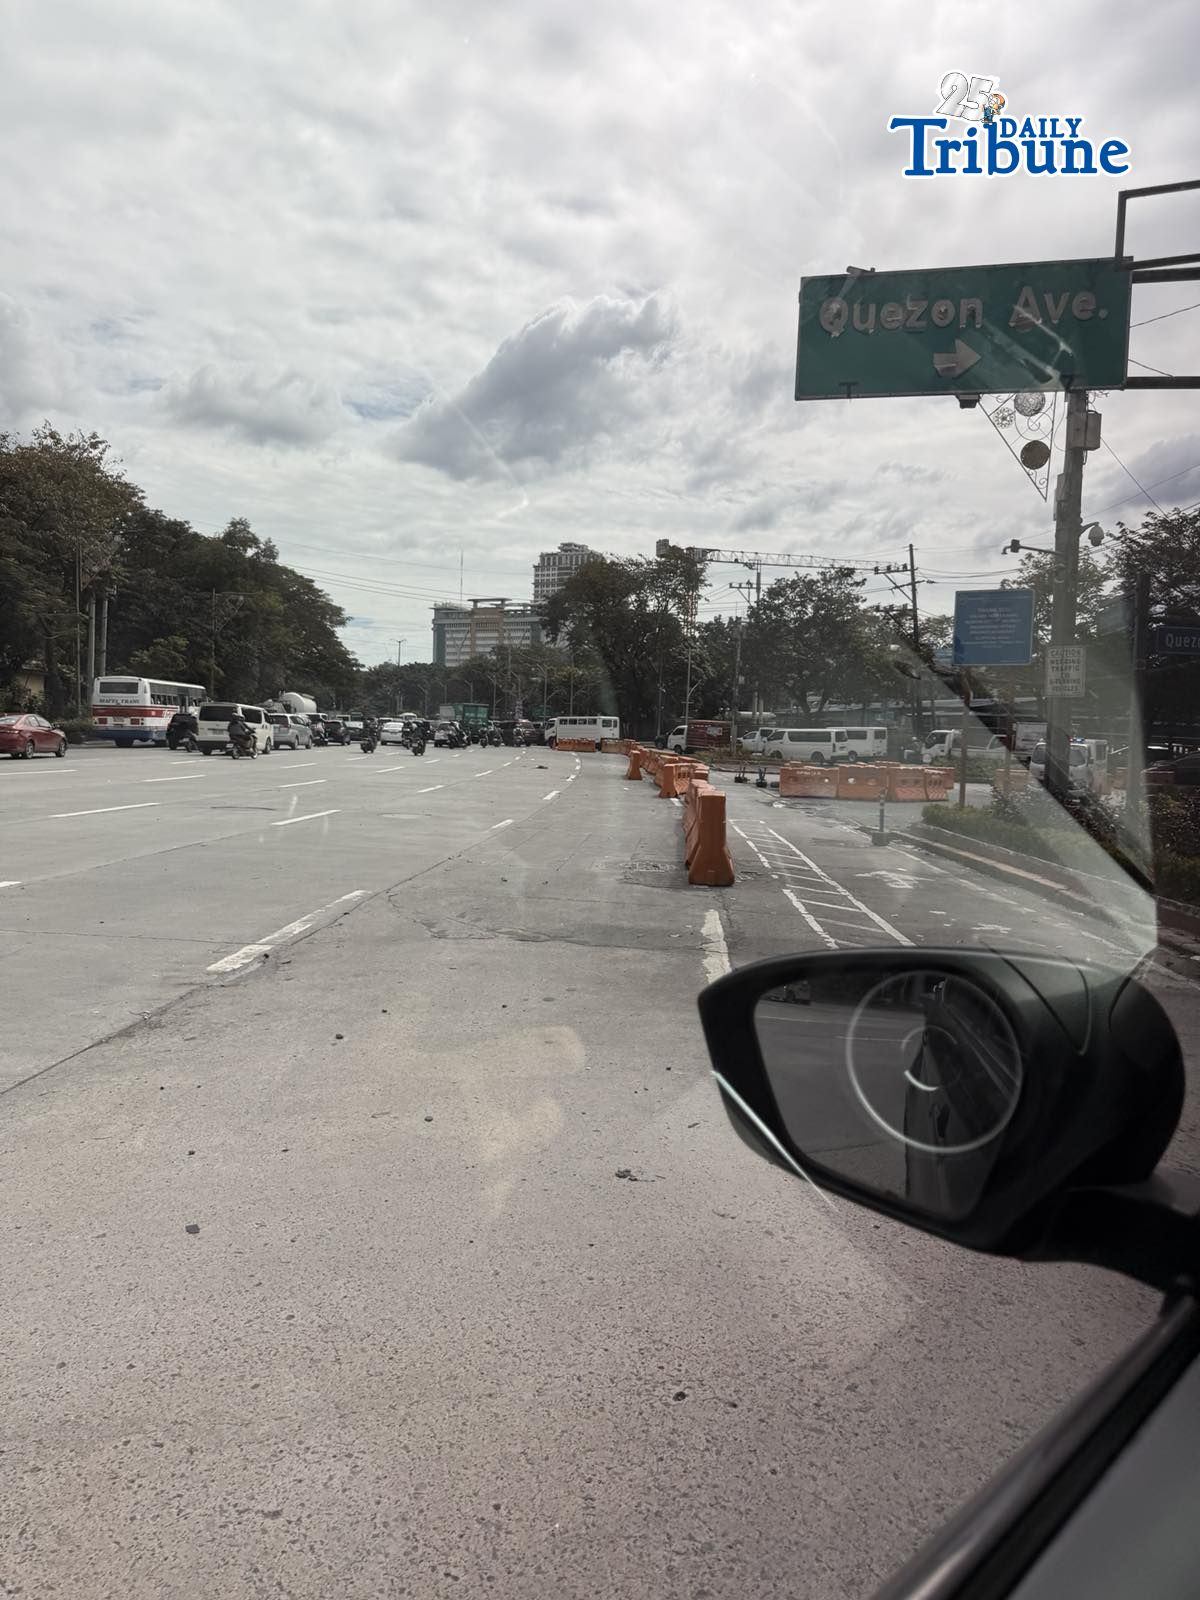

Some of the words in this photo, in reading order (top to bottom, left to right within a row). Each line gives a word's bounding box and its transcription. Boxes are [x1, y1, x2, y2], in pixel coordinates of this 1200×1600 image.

[819, 297, 984, 336] Quezon
[1008, 286, 1108, 325] Ave.
[1051, 664, 1080, 672] TRAFFIC
